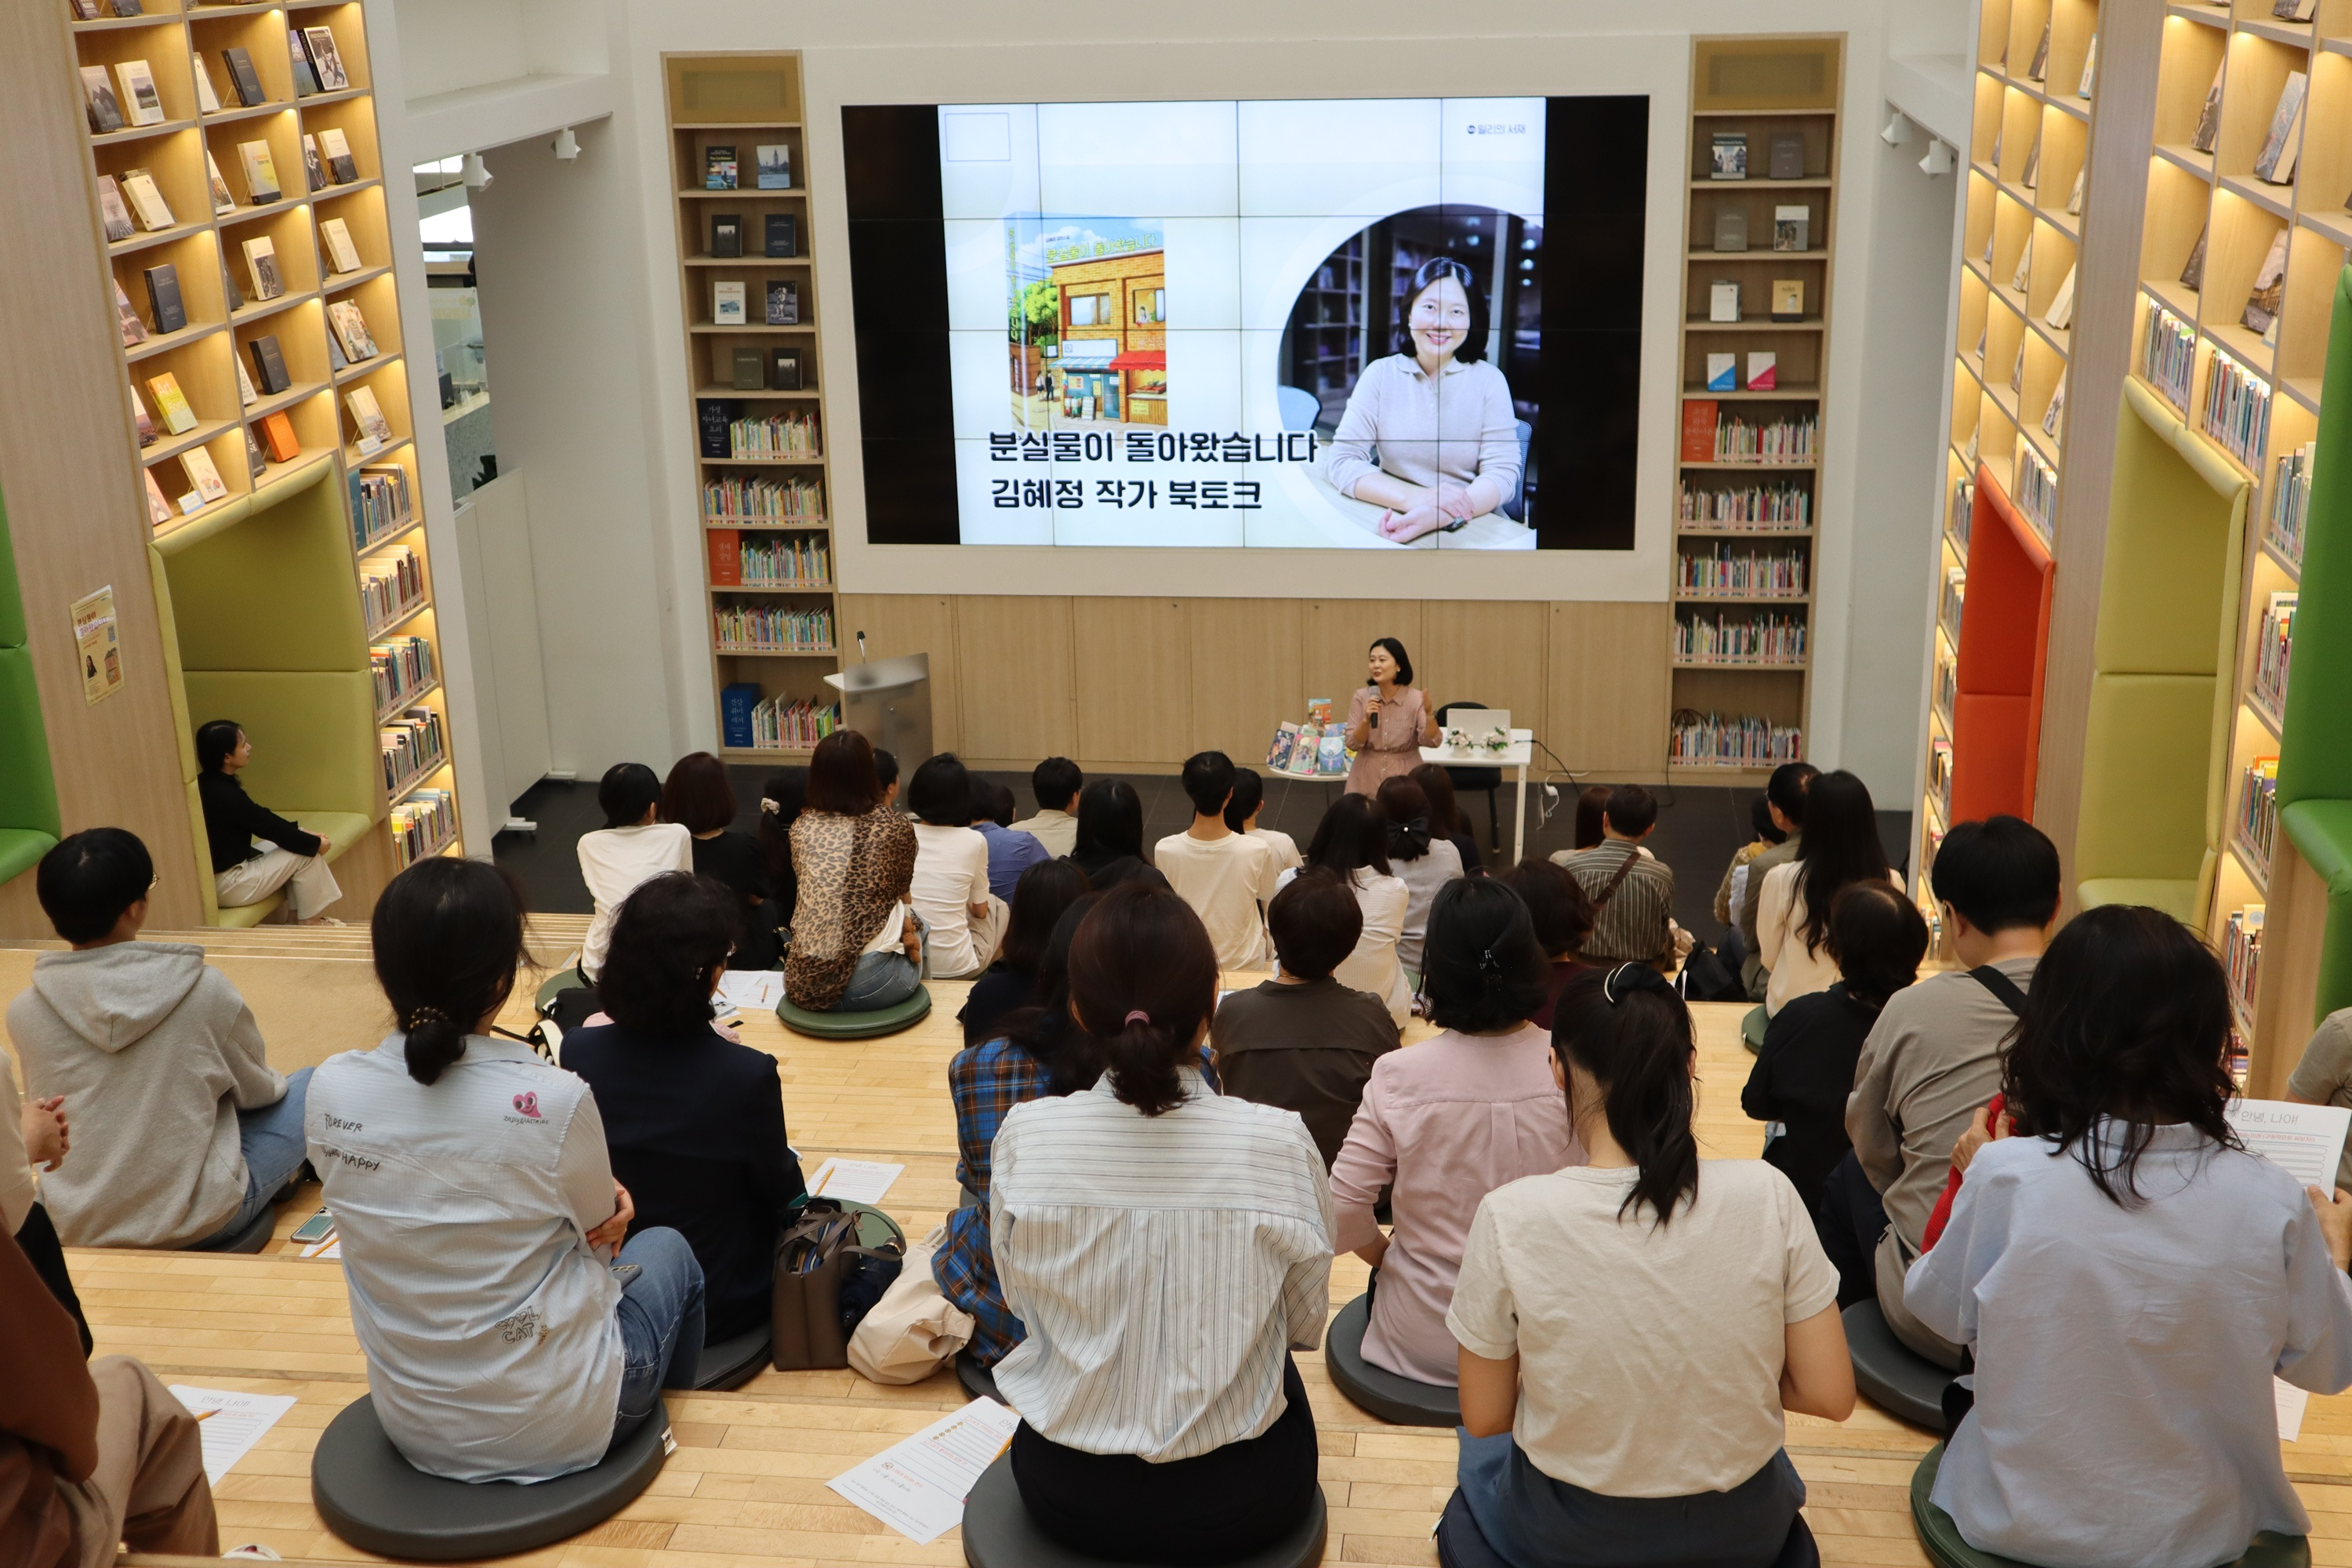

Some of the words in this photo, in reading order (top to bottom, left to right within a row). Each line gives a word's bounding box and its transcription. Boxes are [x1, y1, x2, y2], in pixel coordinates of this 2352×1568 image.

[1046, 242, 1090, 264] 분실물이
[1094, 233, 1156, 256] 돌아왔습니다
[989, 431, 1113, 463] 분실물이
[1126, 431, 1318, 463] 돌아왔습니다
[991, 479, 1083, 508] 김혜정
[1097, 479, 1158, 509] 작가
[1169, 480, 1262, 510] 북토크
[325, 1113, 362, 1133] FOREVER
[2241, 1111, 2267, 1124] 안녕,
[2270, 1112, 2299, 1125] 나야!
[342, 1151, 380, 1171] HAPPY
[502, 1322, 534, 1344] CAT
